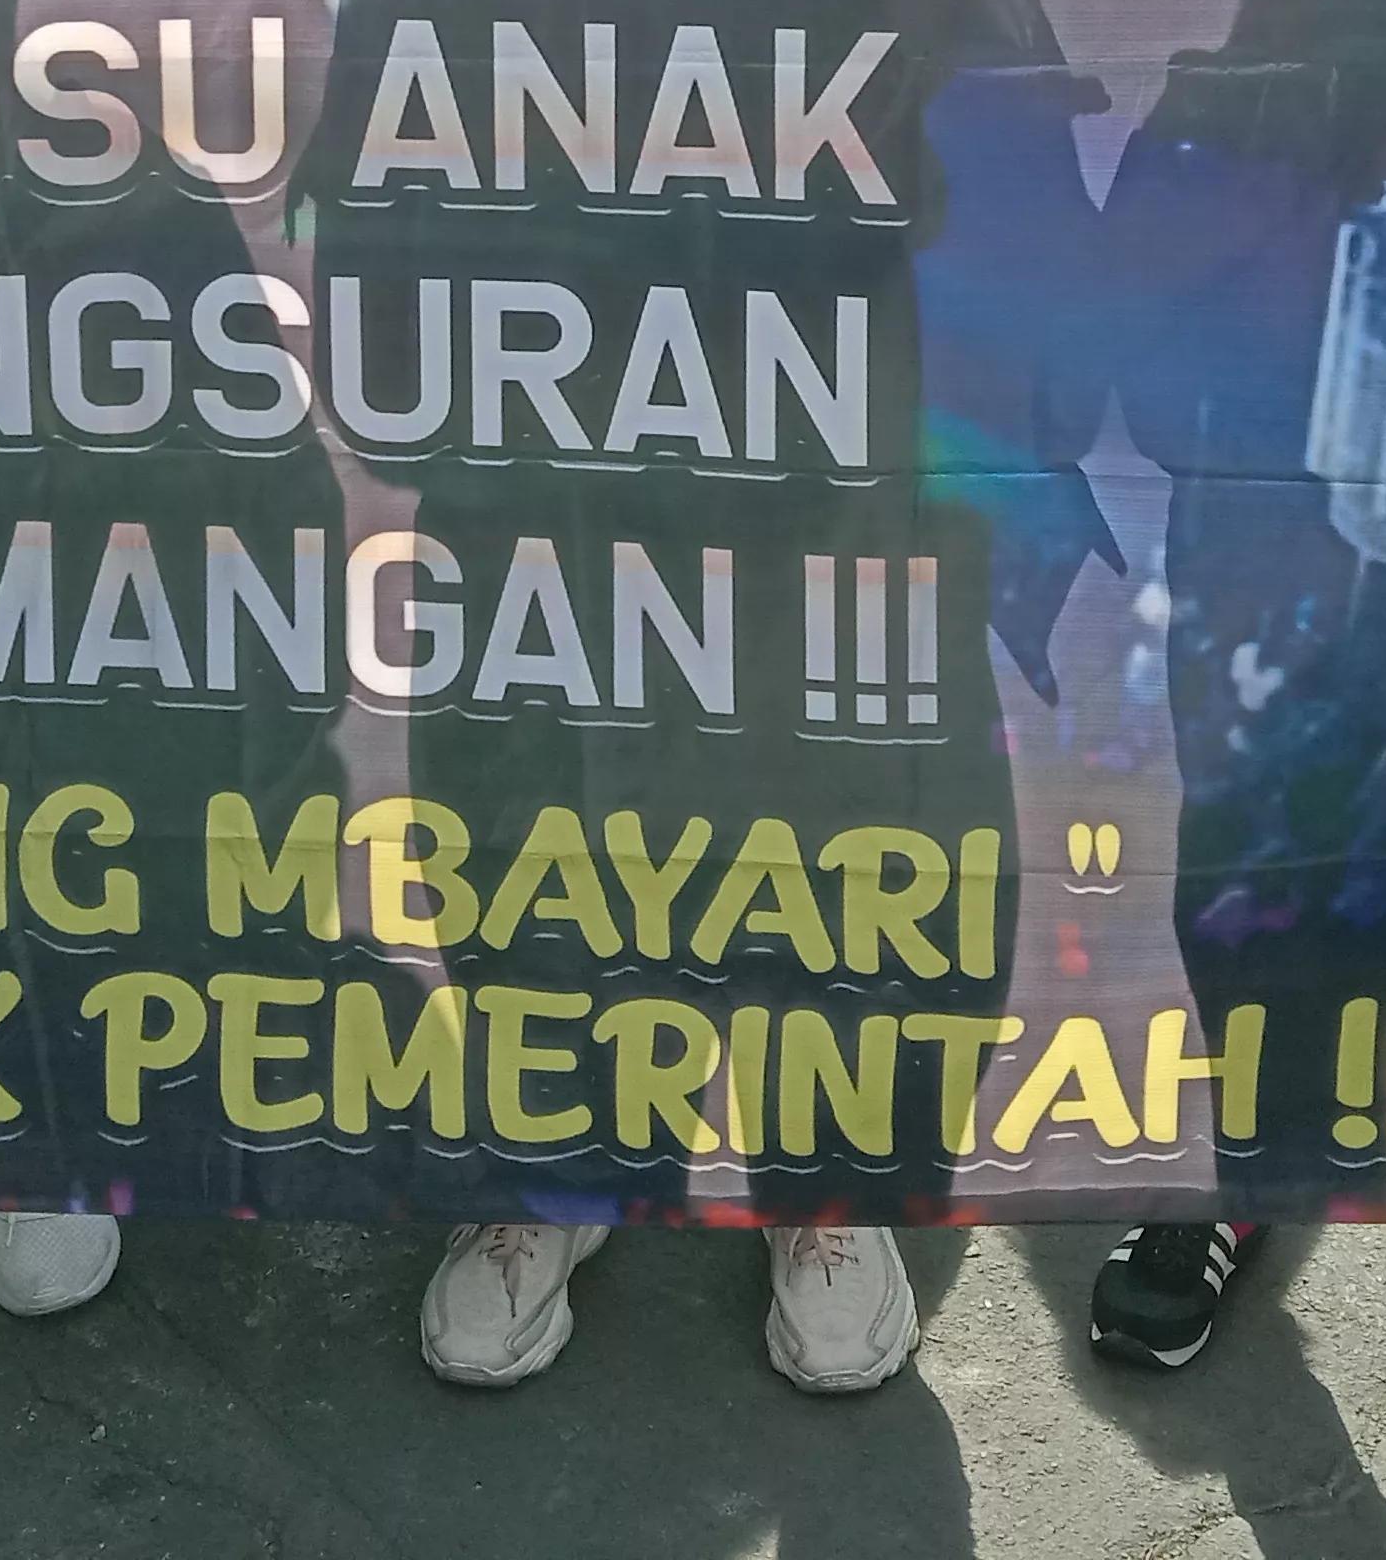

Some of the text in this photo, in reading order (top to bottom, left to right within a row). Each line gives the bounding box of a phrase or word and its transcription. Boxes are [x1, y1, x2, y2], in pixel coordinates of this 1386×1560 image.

[350, 19, 901, 206] ANAK
[206, 790, 1001, 981] MBAYARI
[80, 971, 1266, 1158] PEMERINTAH
